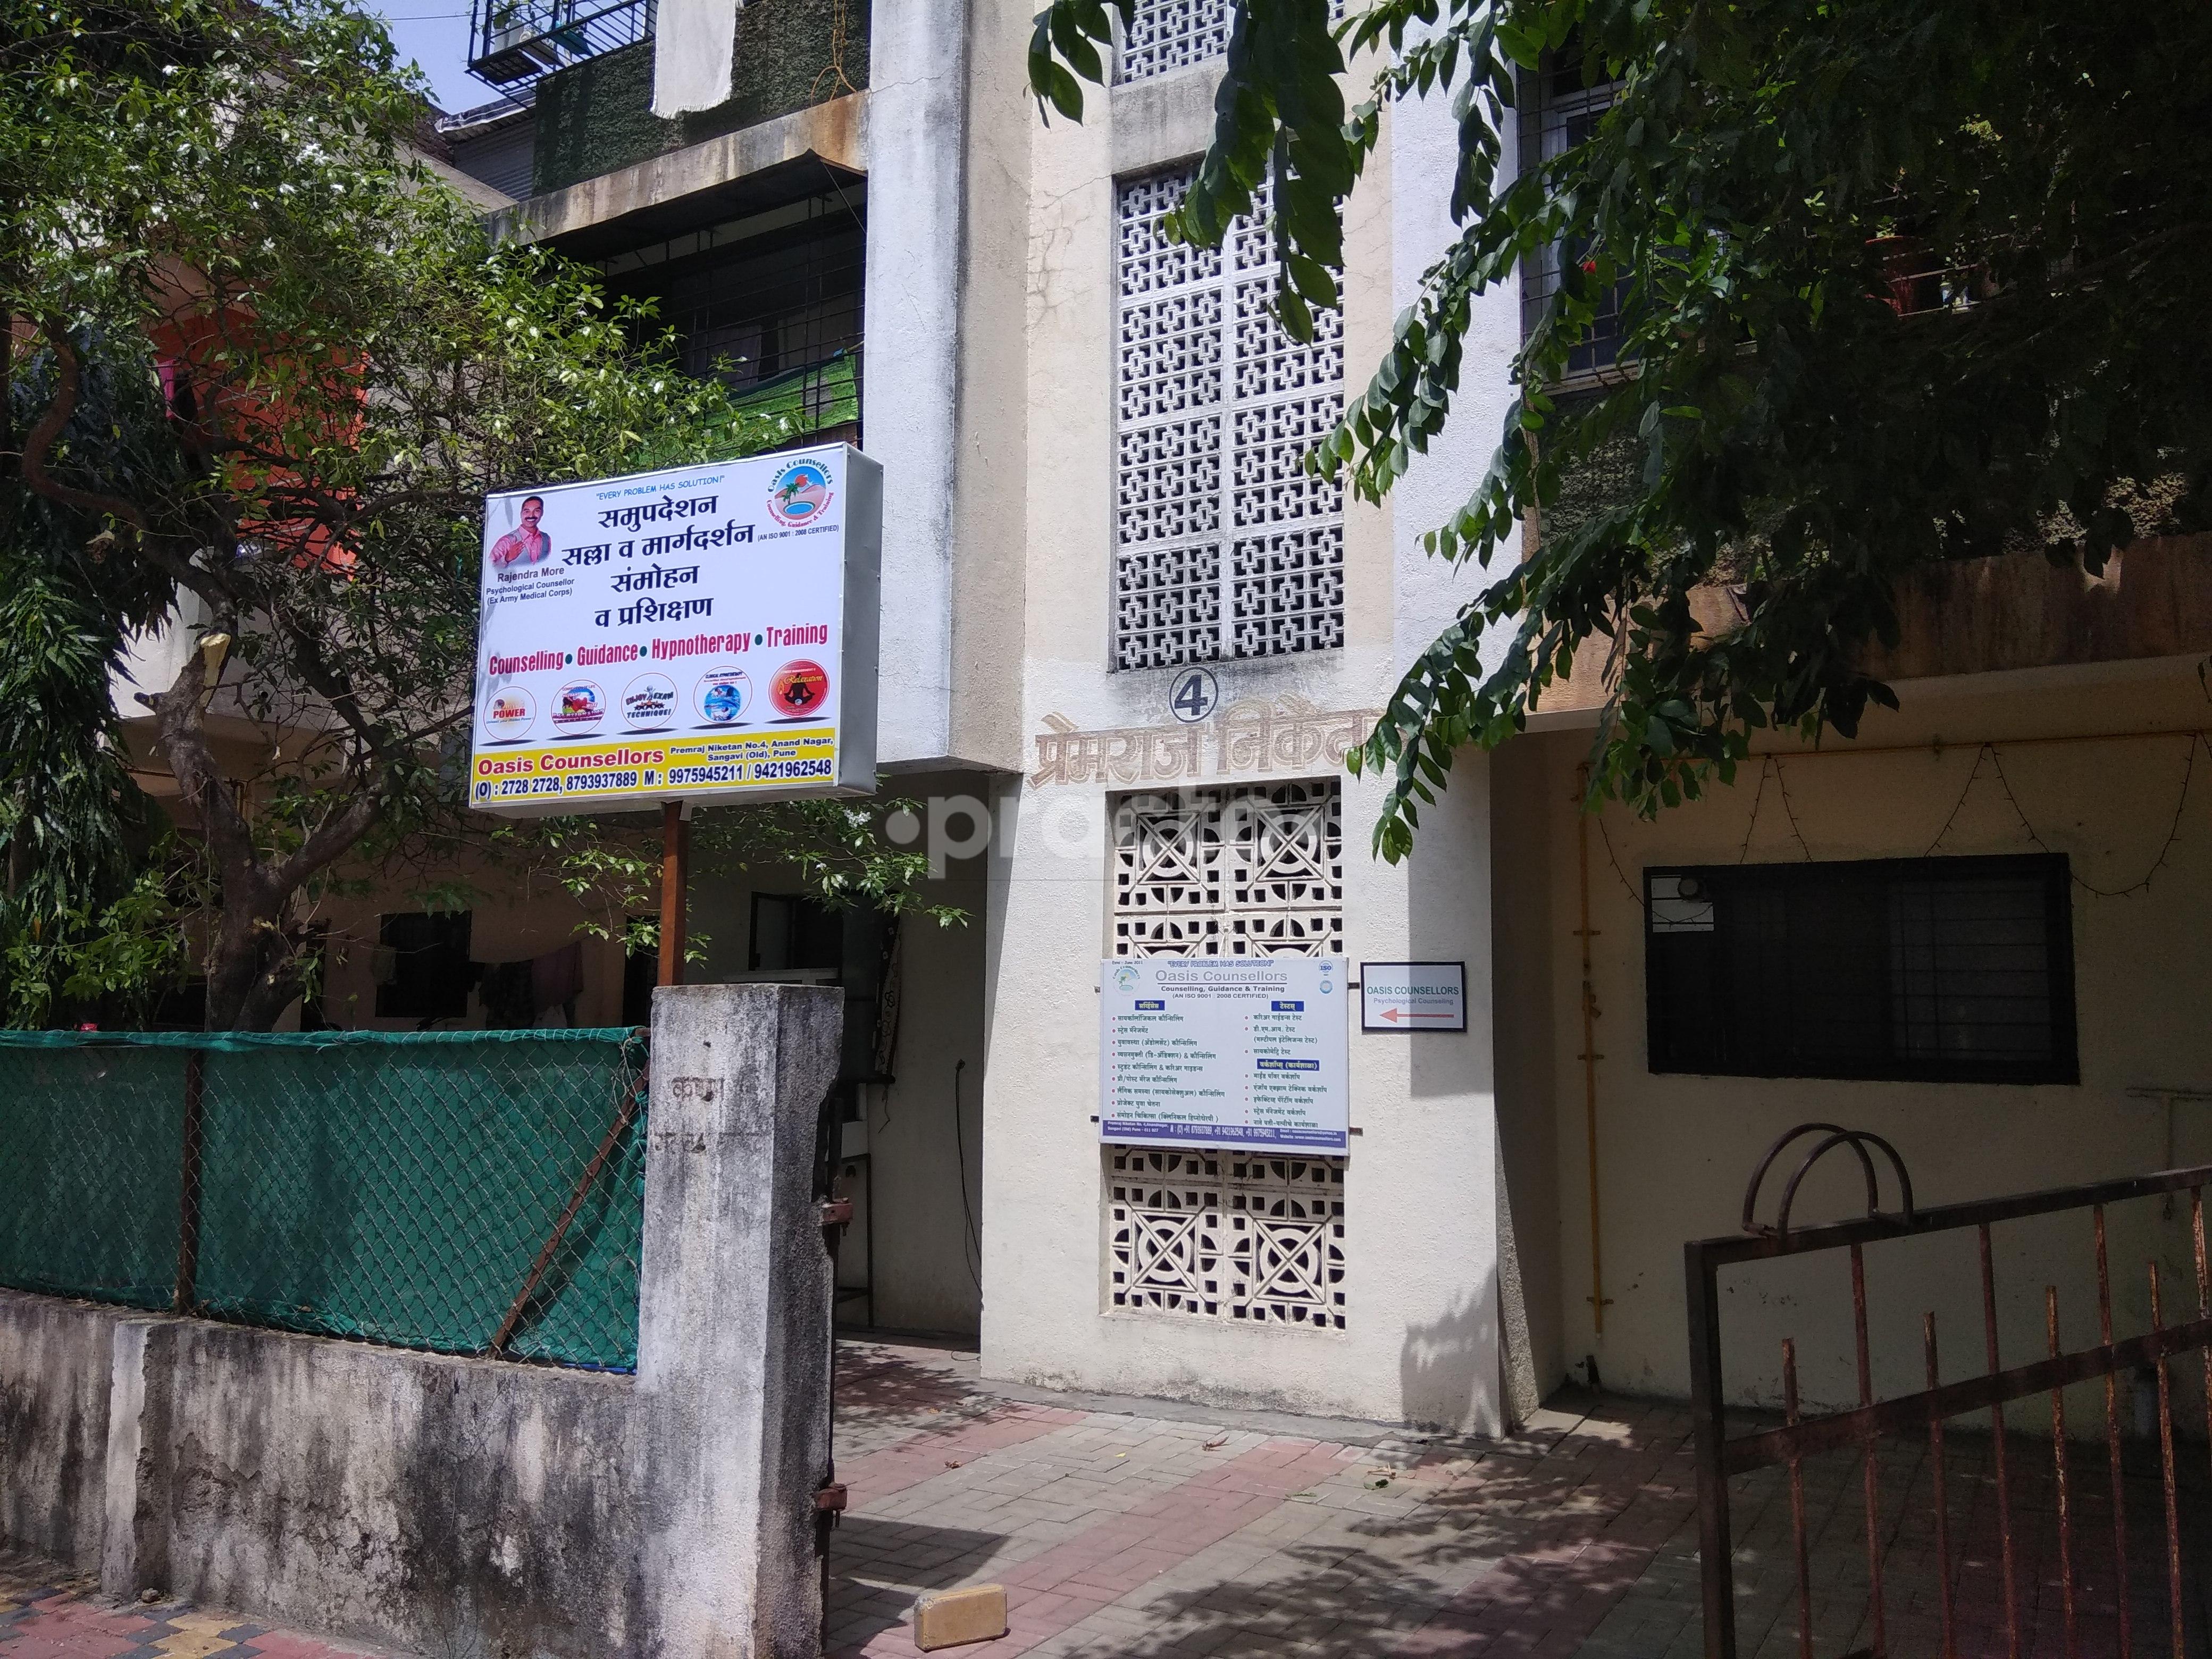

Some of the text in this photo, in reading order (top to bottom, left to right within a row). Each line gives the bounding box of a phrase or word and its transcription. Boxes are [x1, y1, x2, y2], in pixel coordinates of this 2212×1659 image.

[768, 459, 833, 492] Oasis Counsellors
[596, 475, 725, 500] "EVERY PROBLEM HAS SOLUTION!"
[598, 495, 719, 532] समुपदेशन
[562, 519, 756, 565] सल्ला व मार्गदर्शन
[758, 533, 767, 542] (AN
[808, 525, 839, 534] CERTIFIED)
[498, 567, 565, 583] Rajendra More
[610, 563, 700, 592] संमोहन
[486, 579, 574, 596] Psychological Counsellor
[487, 588, 573, 606] (Ex Army Medical Corps)
[595, 597, 714, 627] व प्रशिक्षण
[489, 623, 828, 675] Counselling Guidance Hypnotherapy Training
[653, 691, 673, 700] EXAM
[1174, 674, 1208, 716] 4
[493, 709, 525, 719] POWER
[627, 708, 671, 718] TECHNIQUE!
[671, 745, 705, 754] Premraj
[708, 743, 742, 752] Niketan
[771, 739, 800, 747] Anand
[803, 738, 833, 746] Nagar,
[1027, 693, 1408, 790] प्रेमराज निकेत
[478, 749, 664, 775] Oasis Counsellors
[708, 752, 743, 761] Sangavi
[746, 751, 770, 760] (Old),
[501, 779, 529, 795] 2728
[532, 777, 563, 794] 2728,
[566, 772, 637, 791] 8793937889
[669, 764, 742, 784] 9975945211
[755, 759, 832, 778] 9421962548
[1155, 970, 1287, 981] Oasis Counsellors
[1367, 986, 1459, 995] OASIS COUNSELLORS
